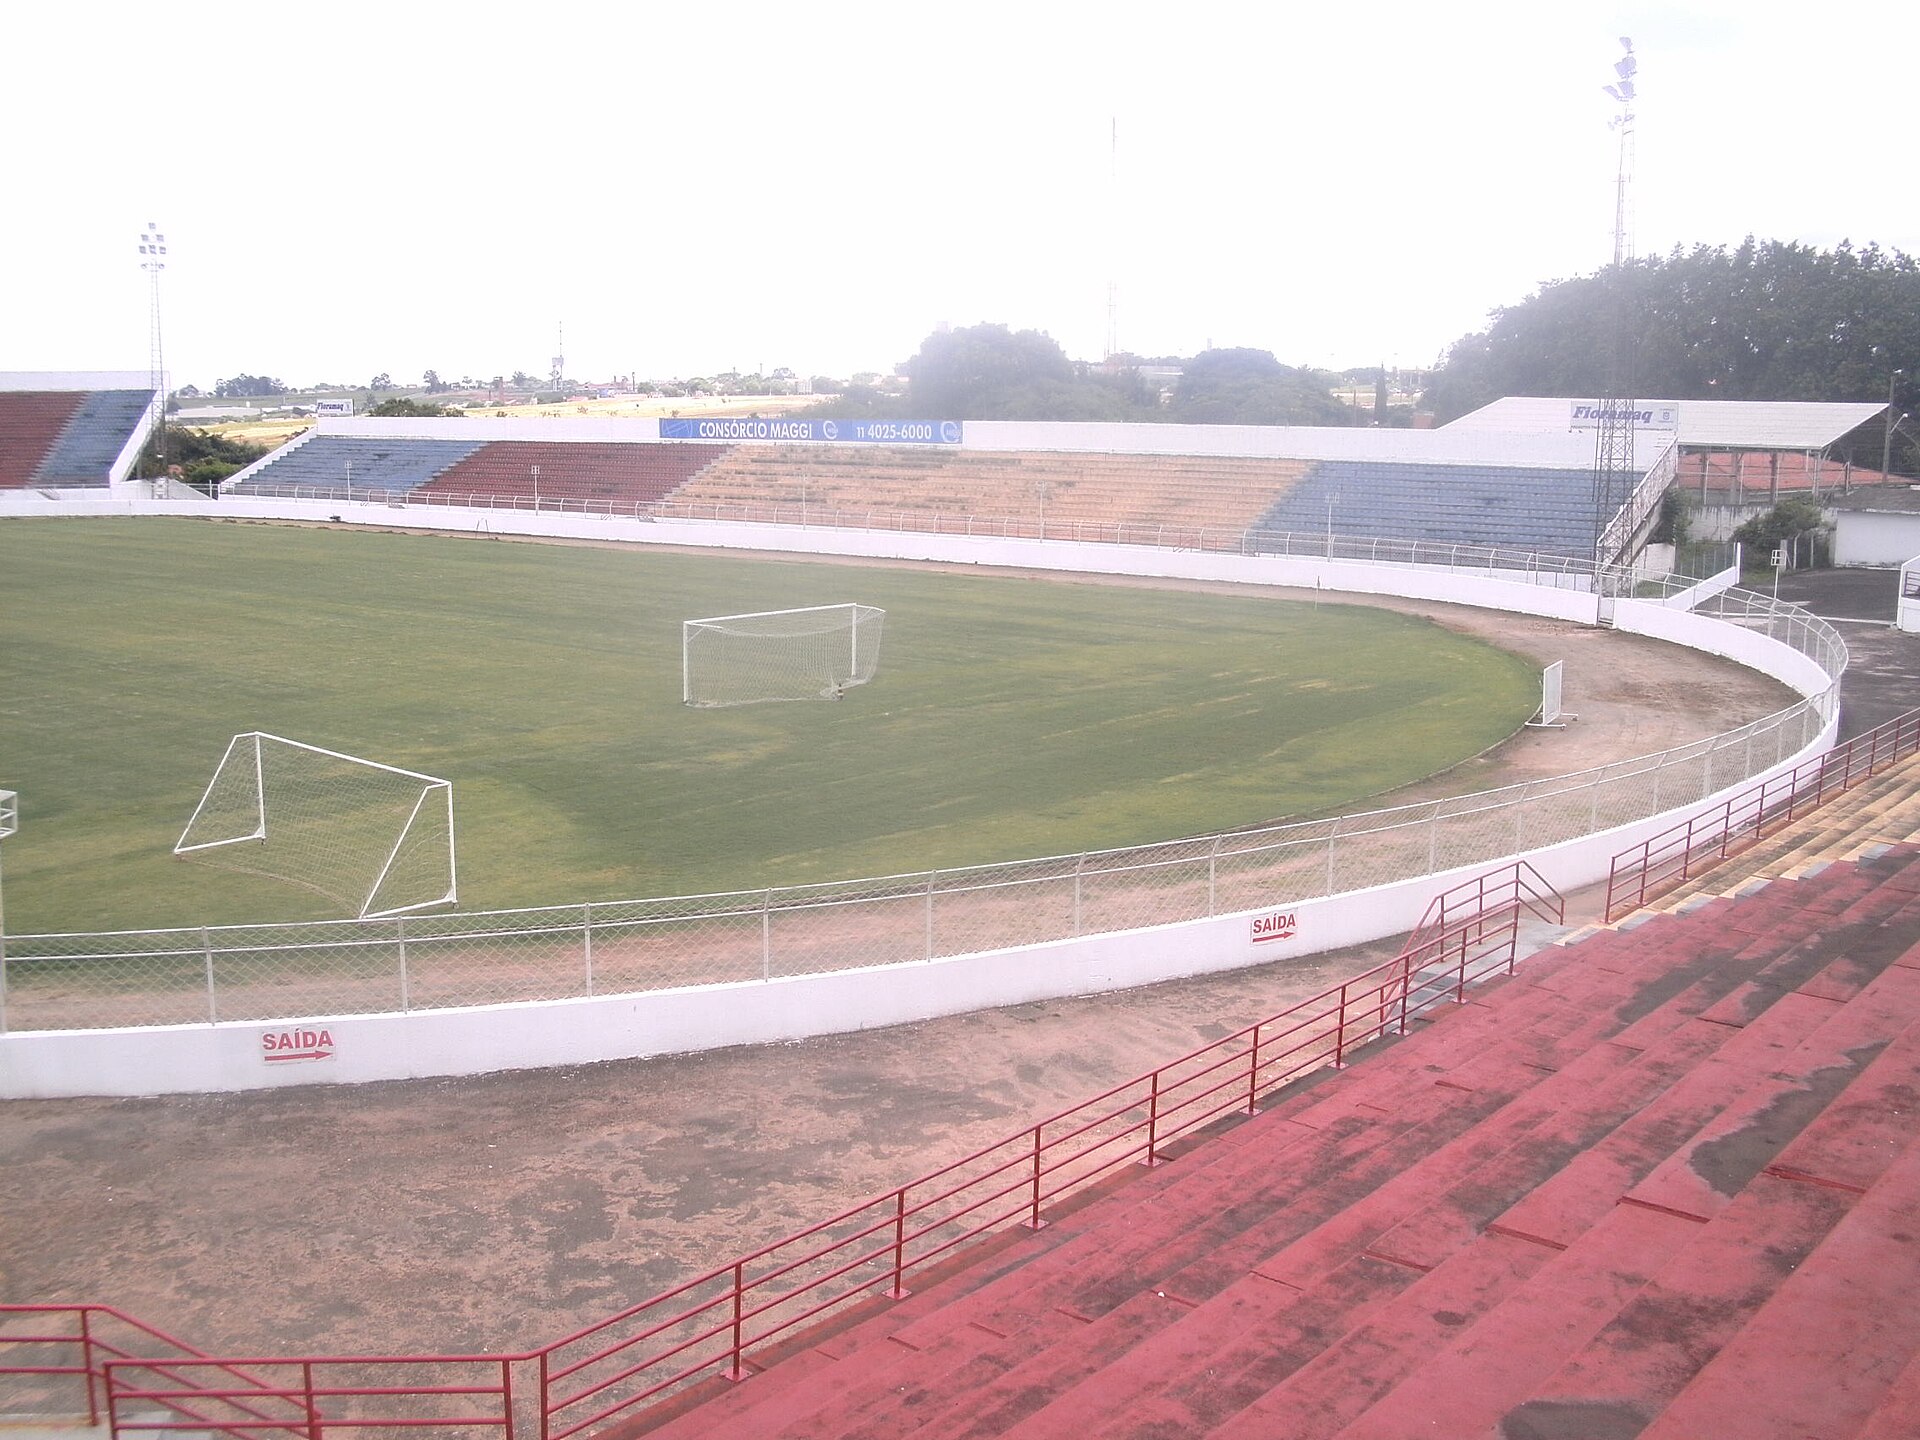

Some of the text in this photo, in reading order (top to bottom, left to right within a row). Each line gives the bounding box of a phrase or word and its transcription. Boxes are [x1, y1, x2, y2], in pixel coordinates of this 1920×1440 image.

[699, 420, 767, 438] CONSÓRCIO
[770, 423, 813, 438] MAGGI
[867, 424, 932, 439] 4025-6000
[1253, 913, 1296, 933] SAÍDA
[262, 1028, 333, 1050] SAÍDA
